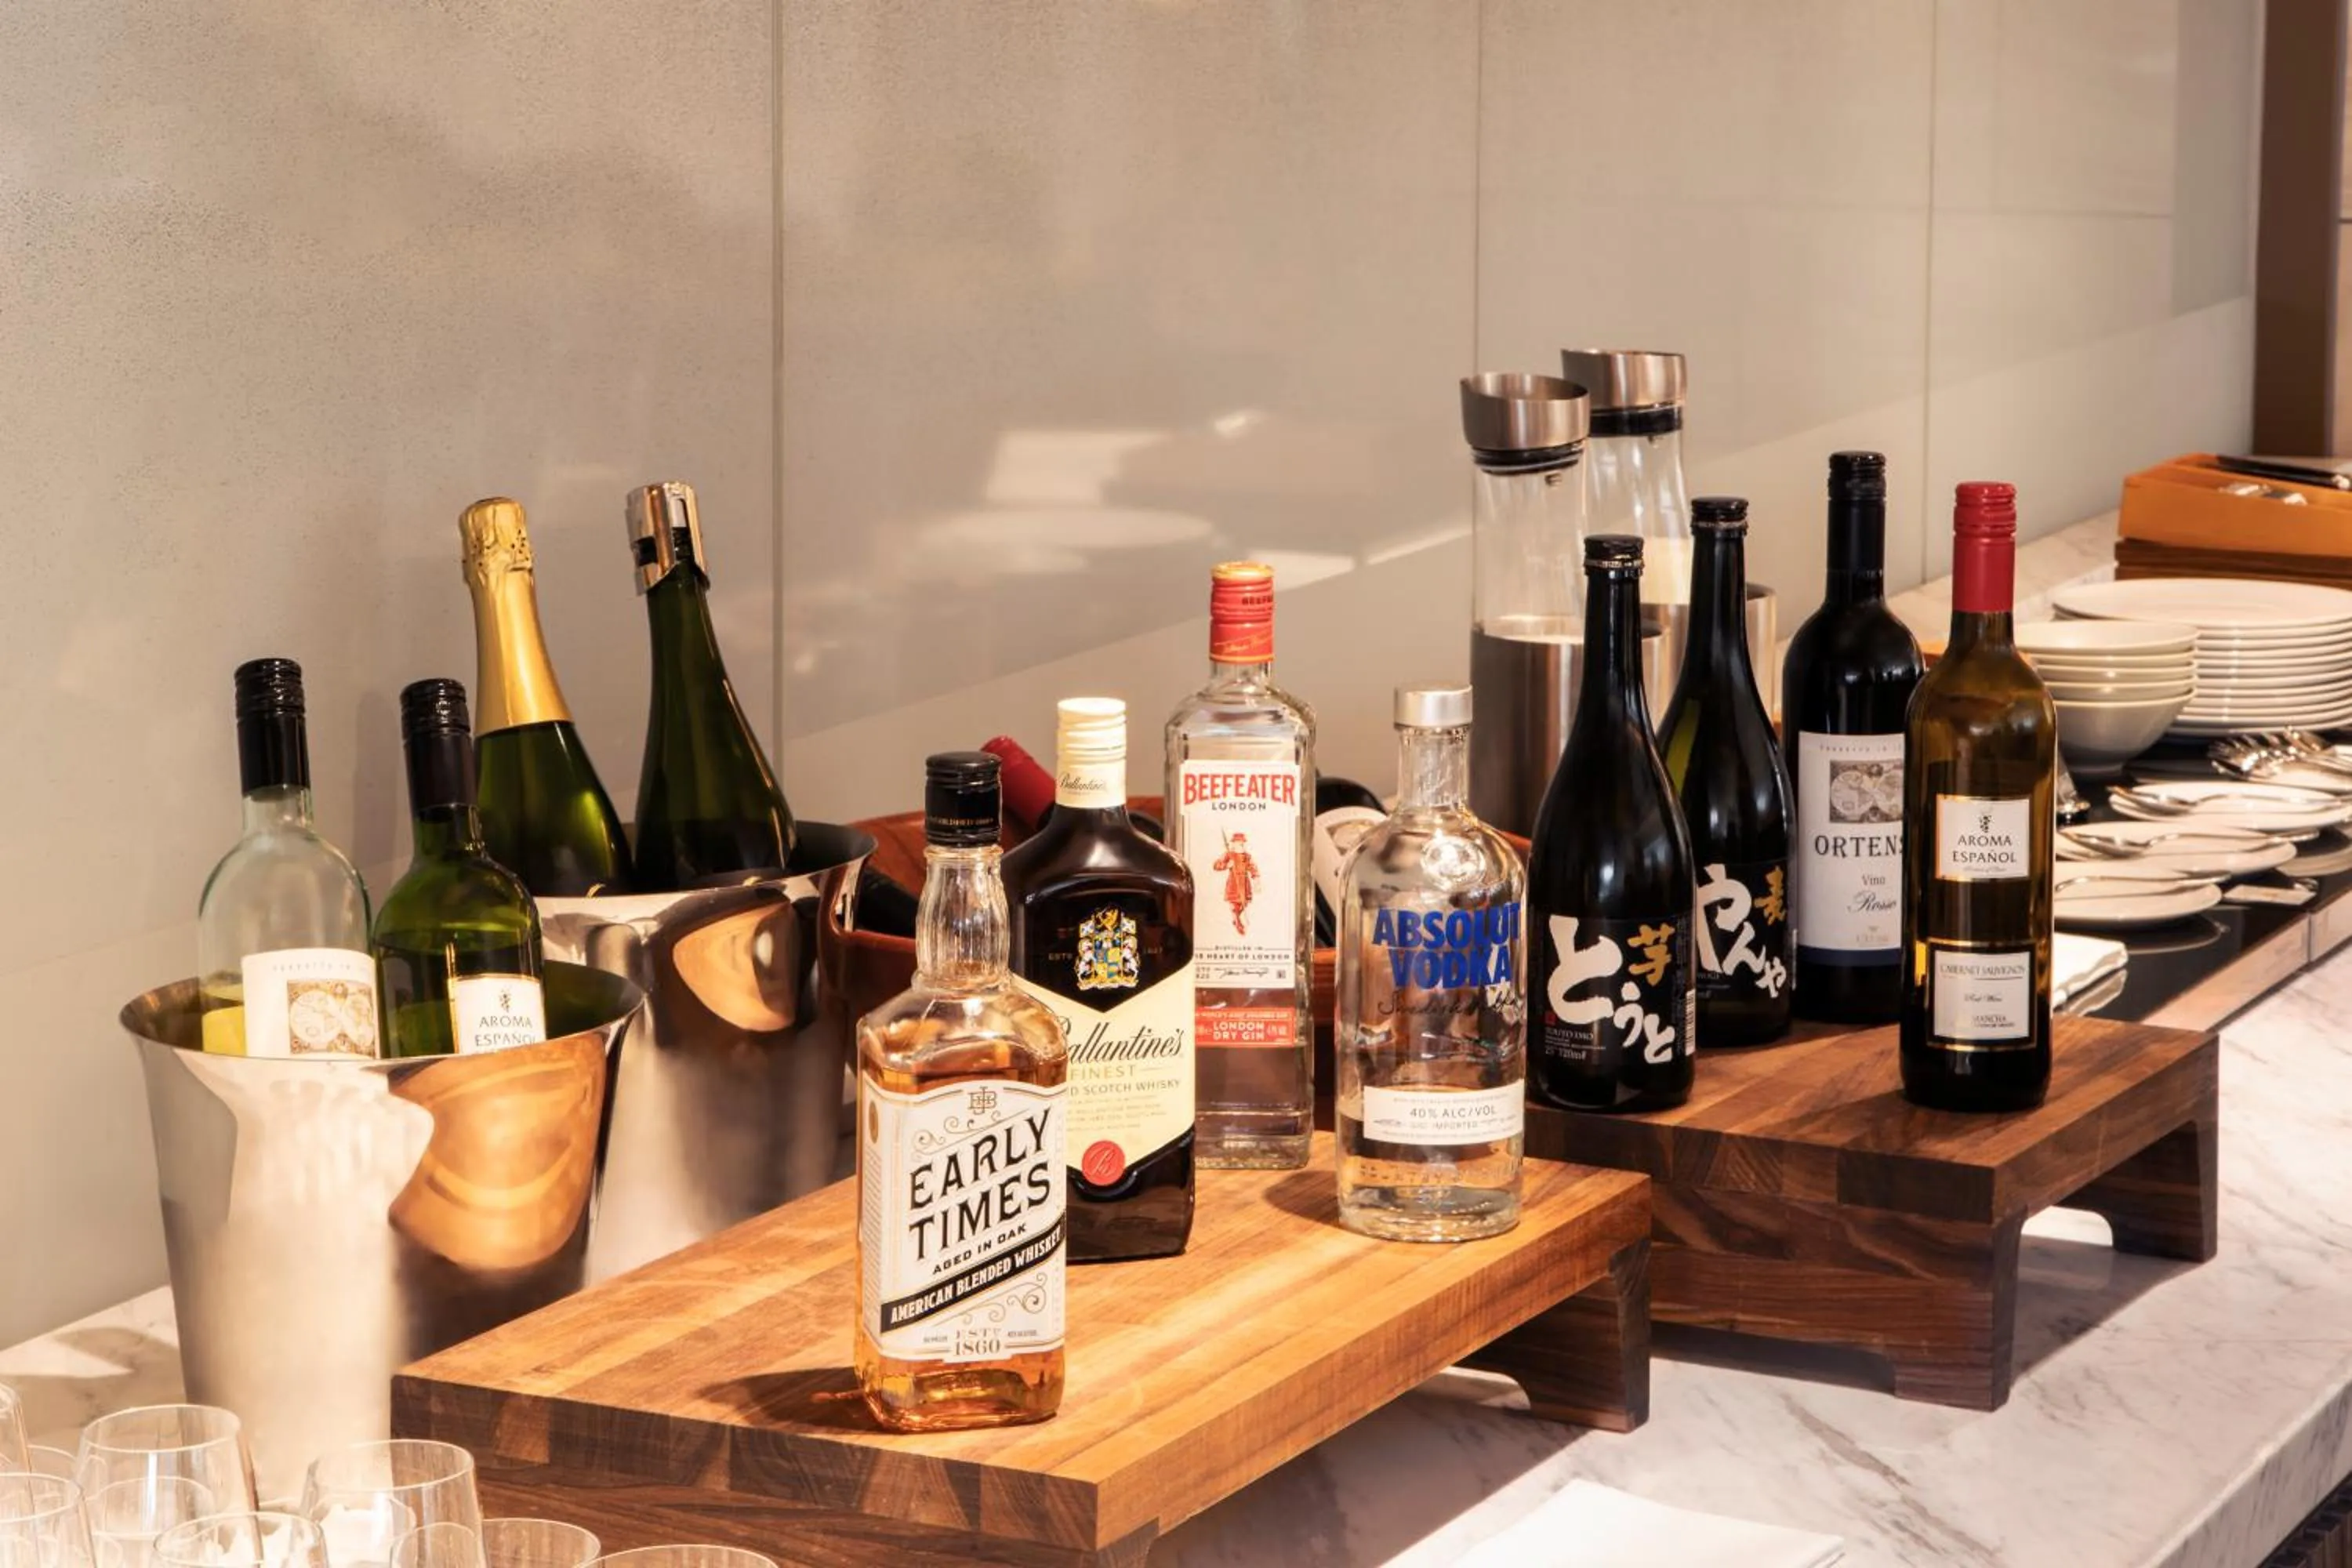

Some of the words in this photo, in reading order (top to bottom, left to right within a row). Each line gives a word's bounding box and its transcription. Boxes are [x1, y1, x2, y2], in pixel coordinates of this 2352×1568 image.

[1184, 773, 1295, 807] BEEFEATER
[1211, 802, 1266, 811] LONDON
[1958, 834, 2013, 847] AROMA
[1952, 849, 2016, 863] ESPAÑOL
[1862, 873, 1886, 885] Vino
[1373, 902, 1520, 949] ABSOLUT
[1627, 922, 1675, 986] 芋
[1388, 945, 1512, 989] VODKA
[479, 1015, 533, 1029] AROMA
[1213, 1022, 1265, 1031] LONDON
[1213, 1032, 1238, 1040] DRY
[1242, 1032, 1265, 1040] GIN
[1070, 1065, 1136, 1081] FINEST
[1083, 1083, 1131, 1096] SCOTCH
[1136, 1079, 1181, 1091] WHISKY
[1410, 1108, 1438, 1120] 40%
[1442, 1105, 1497, 1119] ALC/VOL
[909, 1104, 1052, 1210] EARLY
[909, 1161, 1051, 1261] TIMES
[932, 1250, 972, 1276] AGED
[978, 1240, 992, 1254] IN
[997, 1222, 1027, 1243] OAK
[891, 1283, 953, 1324] AMERICAN
[956, 1258, 1011, 1298] BLENDED
[954, 1338, 1000, 1356] 1860
